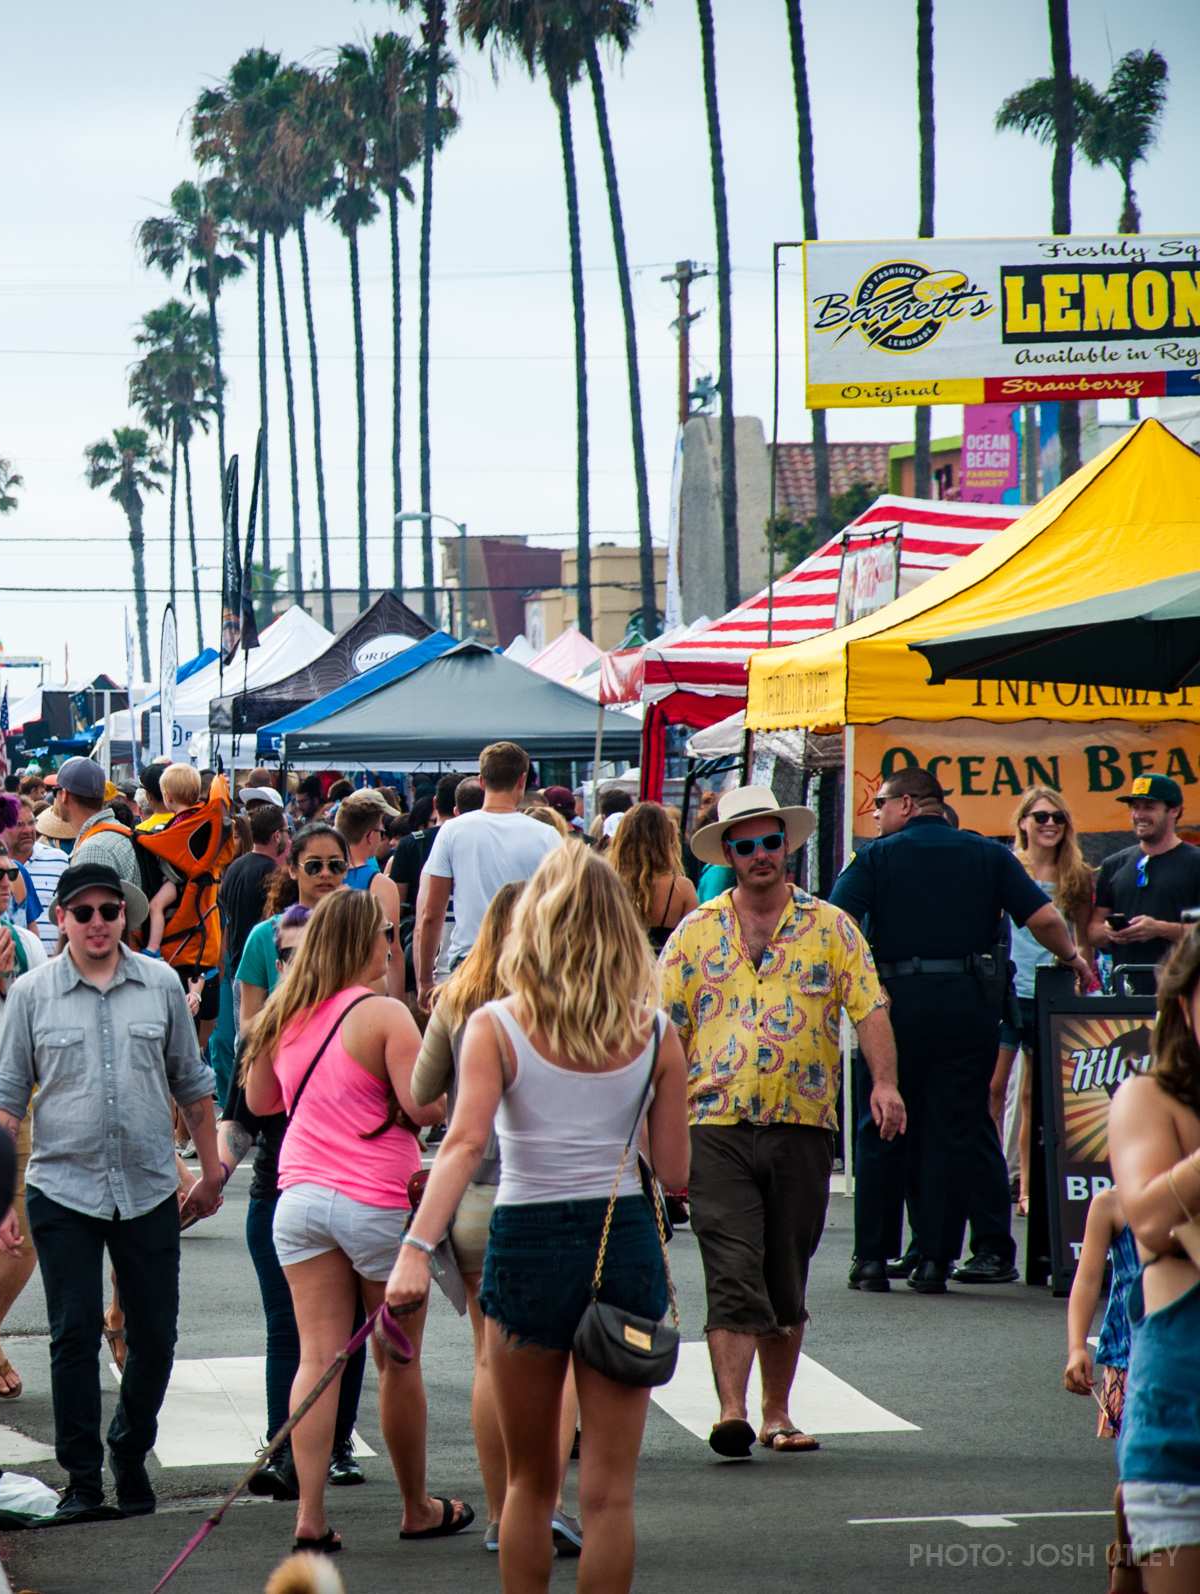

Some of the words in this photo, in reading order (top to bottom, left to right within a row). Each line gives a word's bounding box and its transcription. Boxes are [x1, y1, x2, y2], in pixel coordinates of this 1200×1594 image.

[1038, 241, 1150, 263] Freshly
[861, 285, 874, 300] OLD
[874, 266, 923, 282] FASHIONED
[813, 284, 993, 328] Barrett's
[887, 327, 934, 347] LEMONADE
[1015, 347, 1121, 365] Available
[1127, 347, 1151, 361] in
[841, 382, 944, 402] Original
[1001, 377, 1145, 396] Strawberry
[966, 434, 1010, 450] OCEAN
[966, 452, 1010, 468] BEACH
